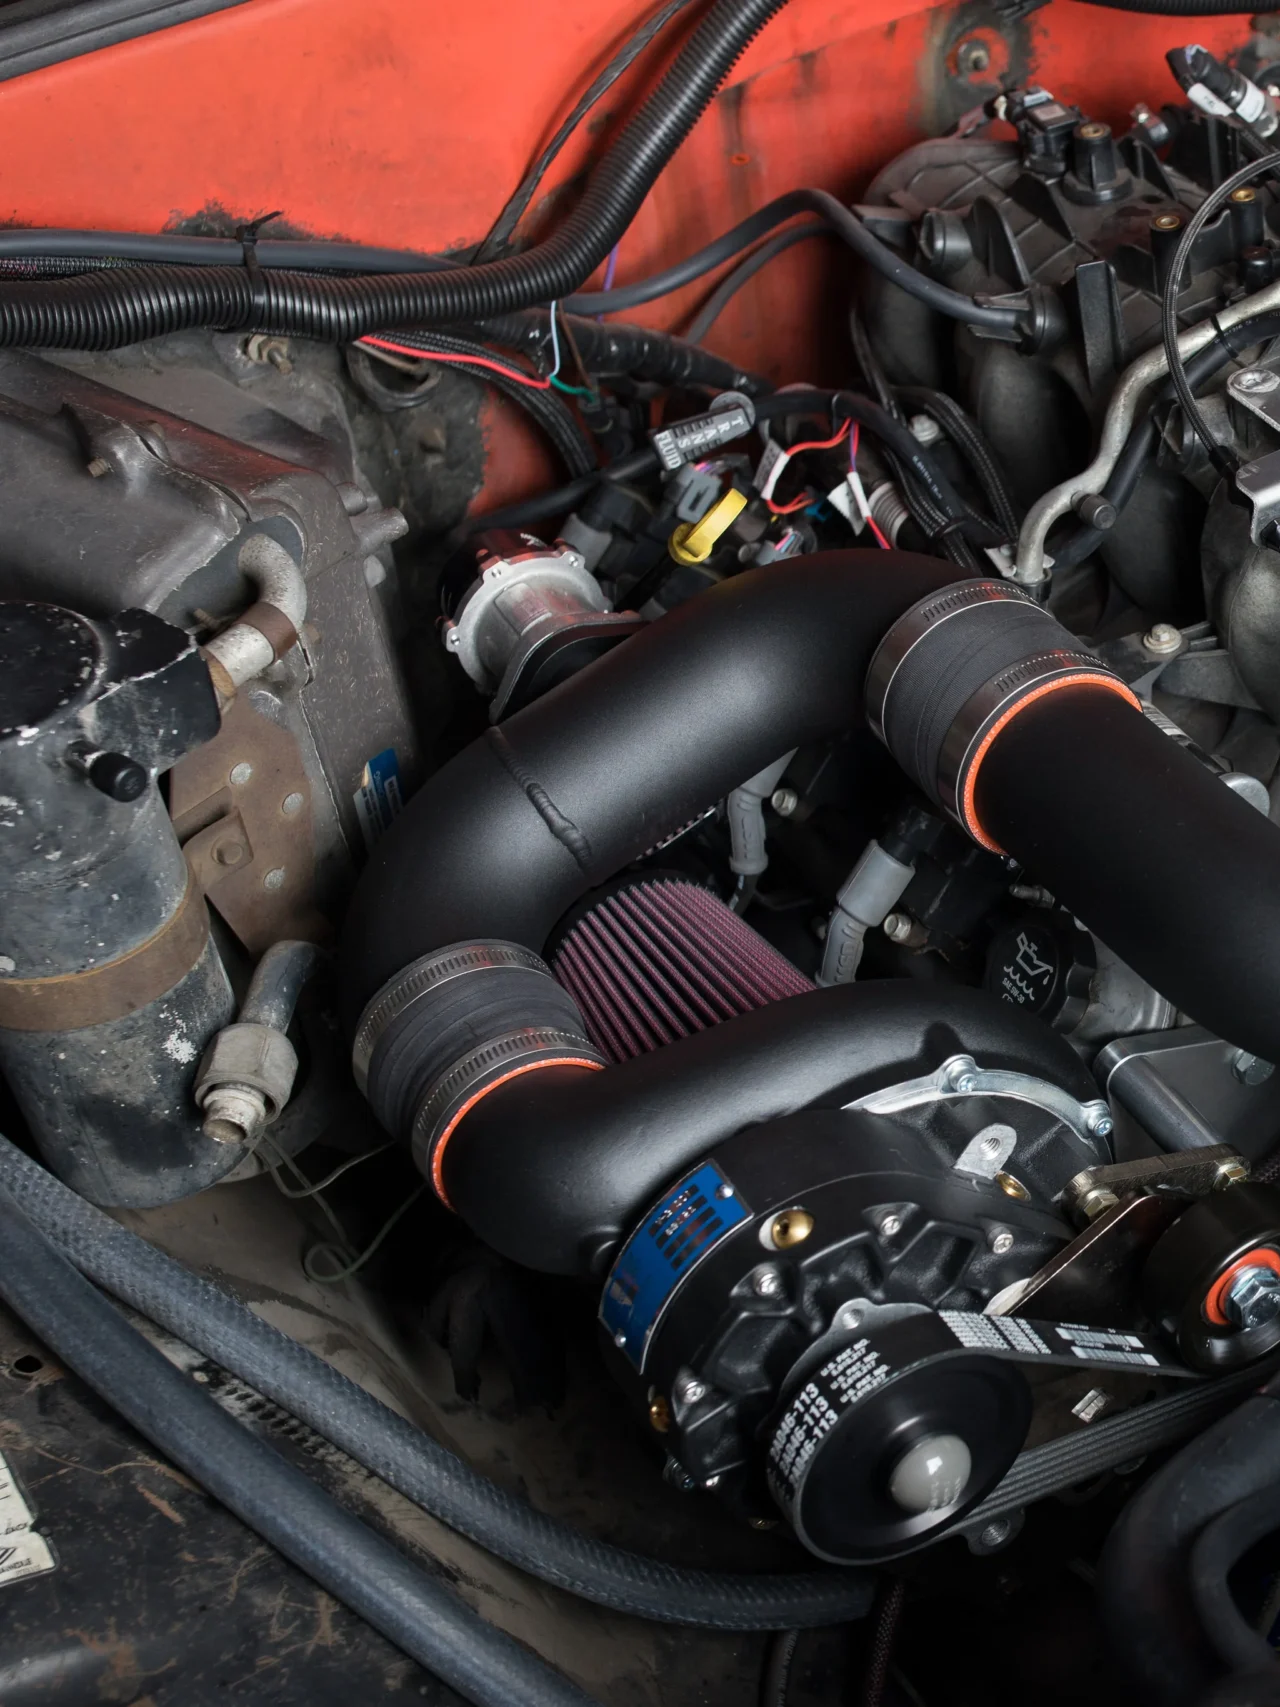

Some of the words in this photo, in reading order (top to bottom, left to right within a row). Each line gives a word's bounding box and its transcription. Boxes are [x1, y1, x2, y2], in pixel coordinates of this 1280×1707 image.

[677, 416, 744, 449] TRANS
[655, 429, 682, 470] FLUID
[1002, 977, 1013, 990] SAE
[1010, 985, 1025, 1004] 5W-30
